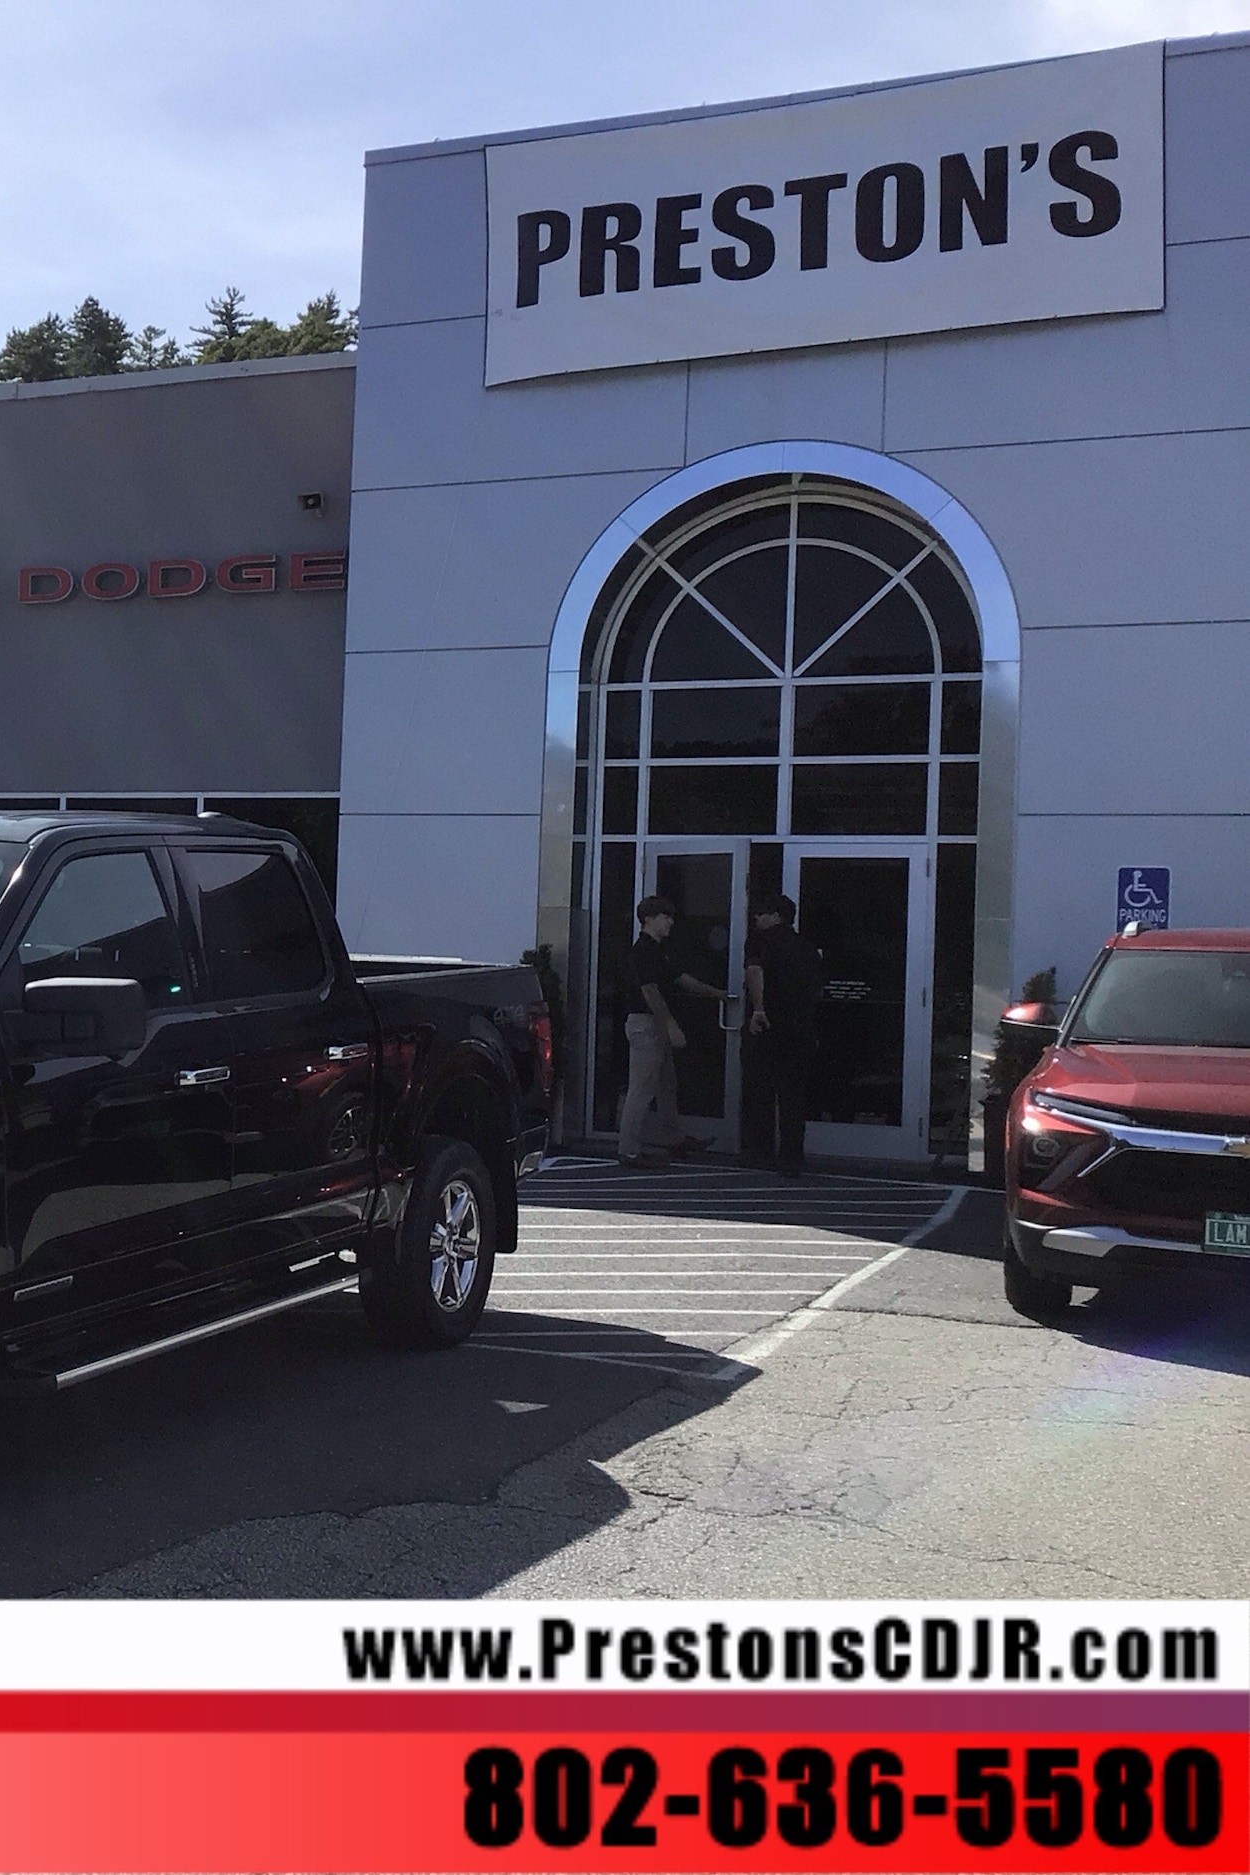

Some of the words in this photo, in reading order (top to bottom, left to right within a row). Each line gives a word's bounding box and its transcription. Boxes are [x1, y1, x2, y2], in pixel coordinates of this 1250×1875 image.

[516, 130, 1122, 309] PRESTON'S
[18, 550, 347, 604] DODGE
[1119, 907, 1167, 923] PARKING
